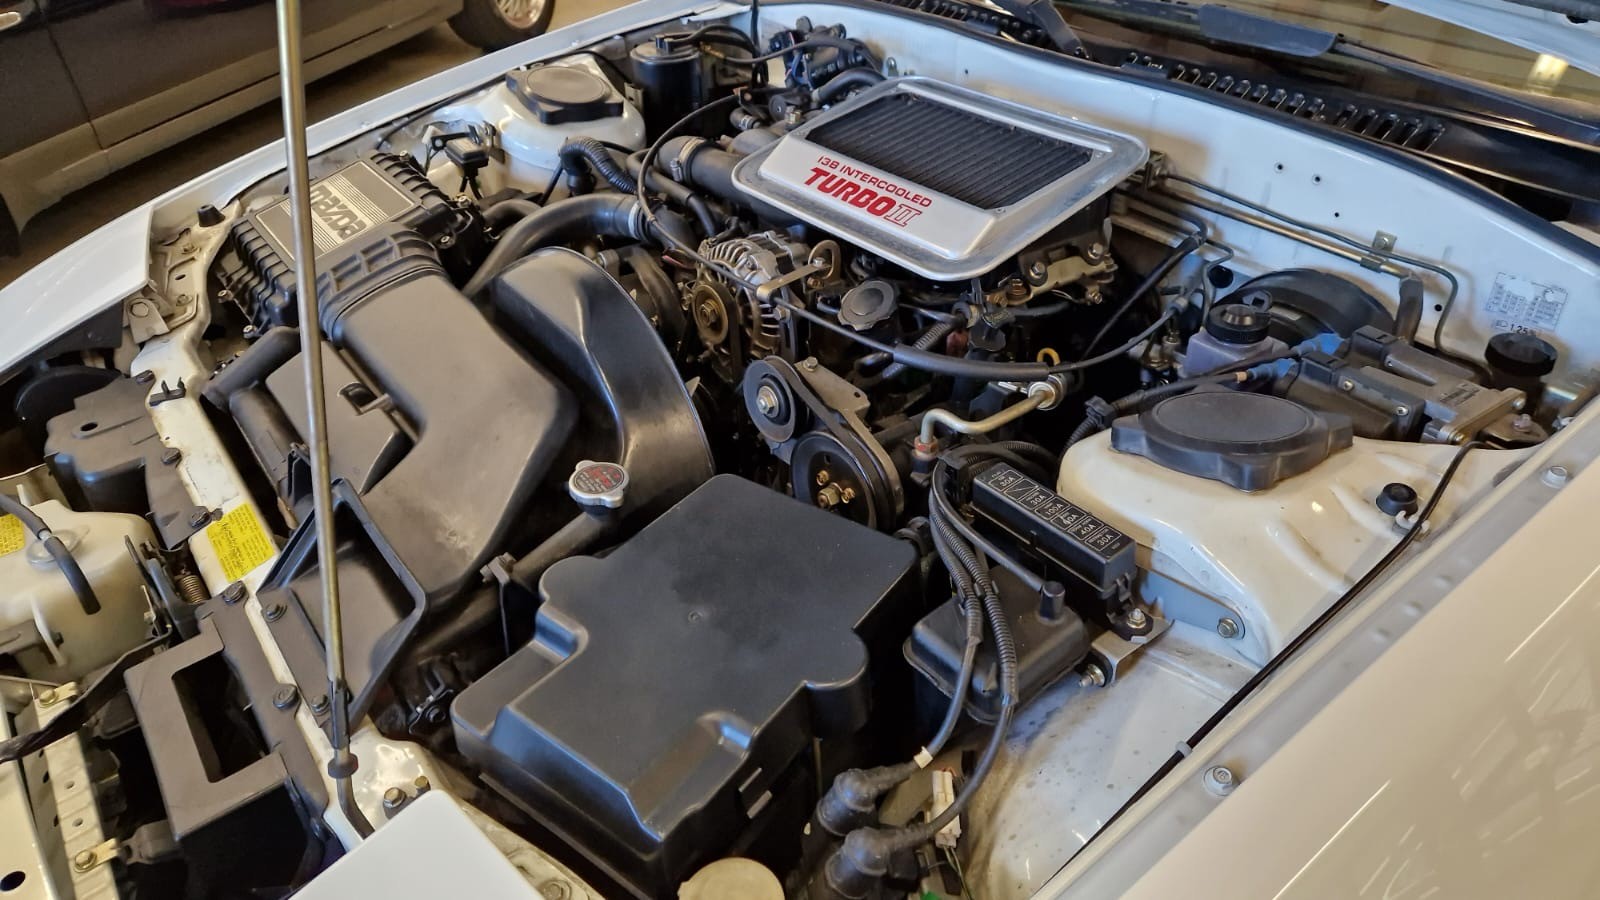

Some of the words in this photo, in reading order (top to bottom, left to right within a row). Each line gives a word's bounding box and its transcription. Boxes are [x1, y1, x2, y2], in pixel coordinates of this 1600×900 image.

[804, 167, 897, 216] TURBO
[840, 165, 933, 207] INTERCOOLED
[1097, 534, 1114, 546] 30A
